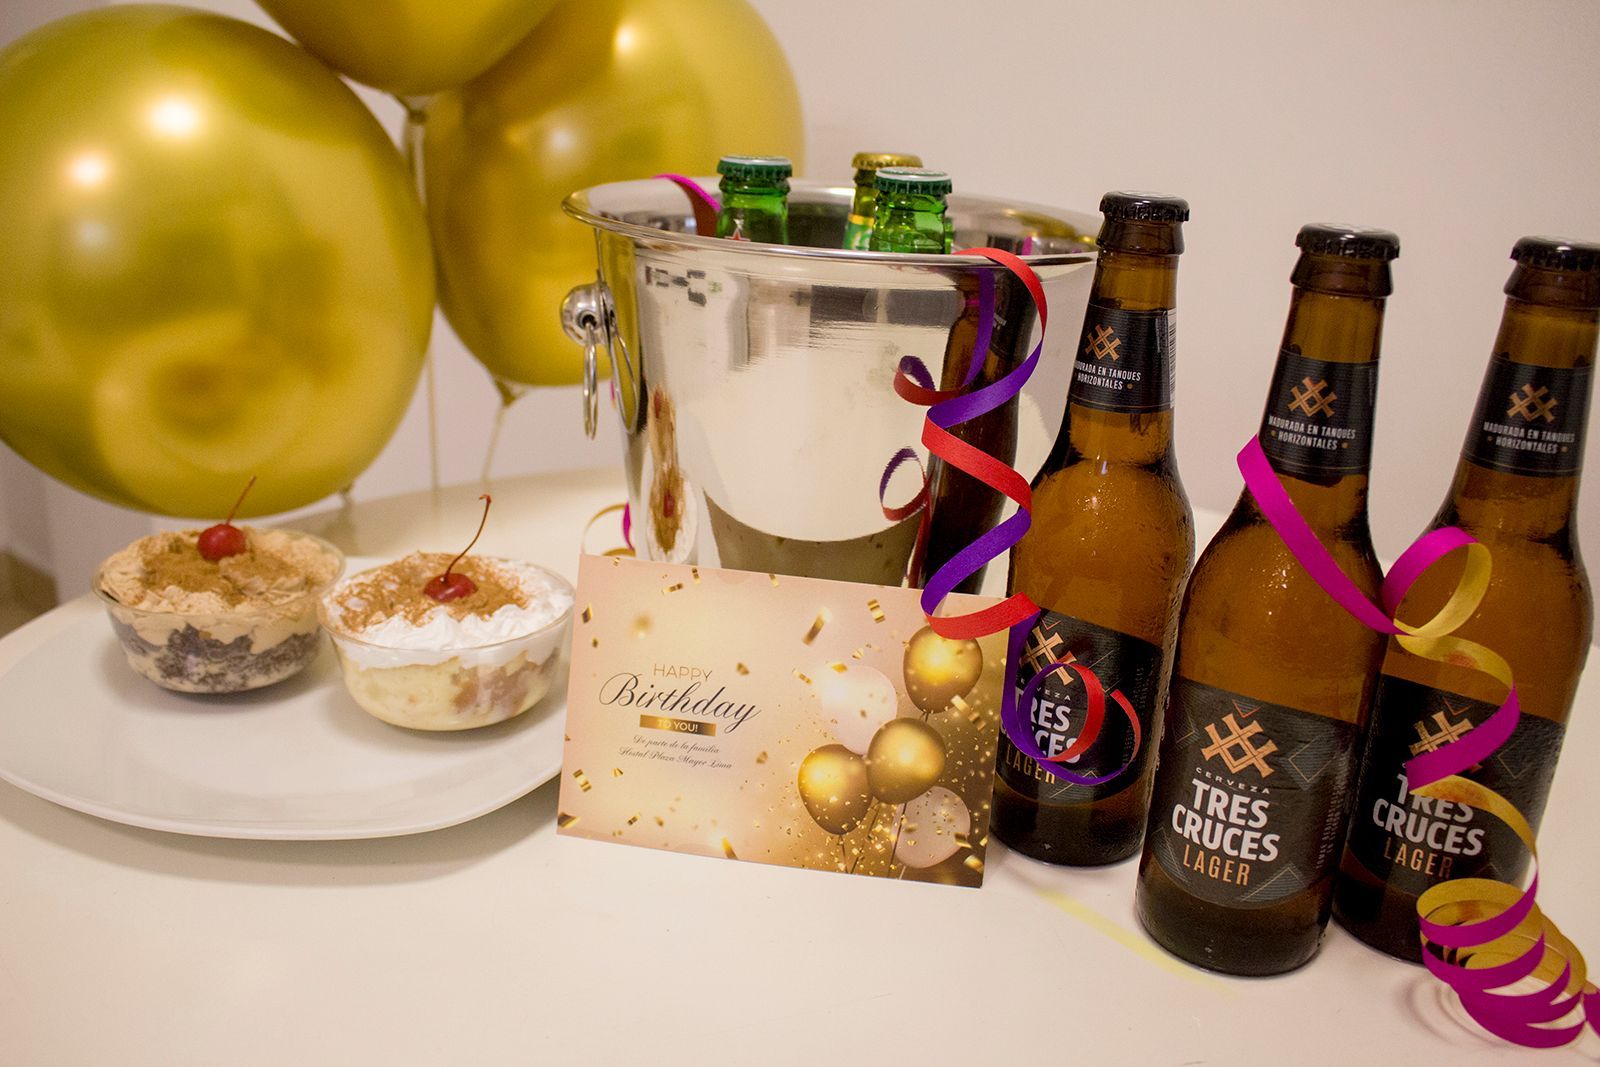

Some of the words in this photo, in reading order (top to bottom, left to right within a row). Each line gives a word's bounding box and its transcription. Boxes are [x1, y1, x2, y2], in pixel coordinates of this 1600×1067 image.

[1077, 372, 1123, 390] HORIZONTALES
[1097, 366, 1106, 376] EN
[1109, 368, 1141, 381] TANQUES
[1268, 415, 1304, 432] MADURADA
[1307, 424, 1319, 435] EN
[1321, 426, 1356, 439] TANQUES
[1483, 421, 1525, 438] MADURADA
[1527, 429, 1539, 440] EN
[1541, 431, 1575, 443] TANQUES
[1278, 430, 1338, 450] HORIZONTALES
[1495, 436, 1559, 454] HORIZONTALES
[653, 663, 713, 682] HAPPY
[599, 672, 762, 734] Birthday
[673, 721, 699, 732] YOU!
[633, 734, 645, 743] De
[645, 738, 668, 748] parte
[669, 740, 679, 749] de
[680, 741, 689, 750] la
[687, 743, 719, 753] familia
[618, 746, 648, 759] Hostal
[649, 751, 675, 761] Plaza
[677, 755, 707, 767] Mayor
[709, 760, 733, 769] Lima
[1196, 767, 1271, 794] CERVEZA
[1192, 778, 1270, 829] TRES
[1172, 803, 1281, 862] CRUCES
[1372, 798, 1486, 856] CRUCES
[1183, 844, 1250, 886] LAGER
[1384, 837, 1454, 879] LAGER
